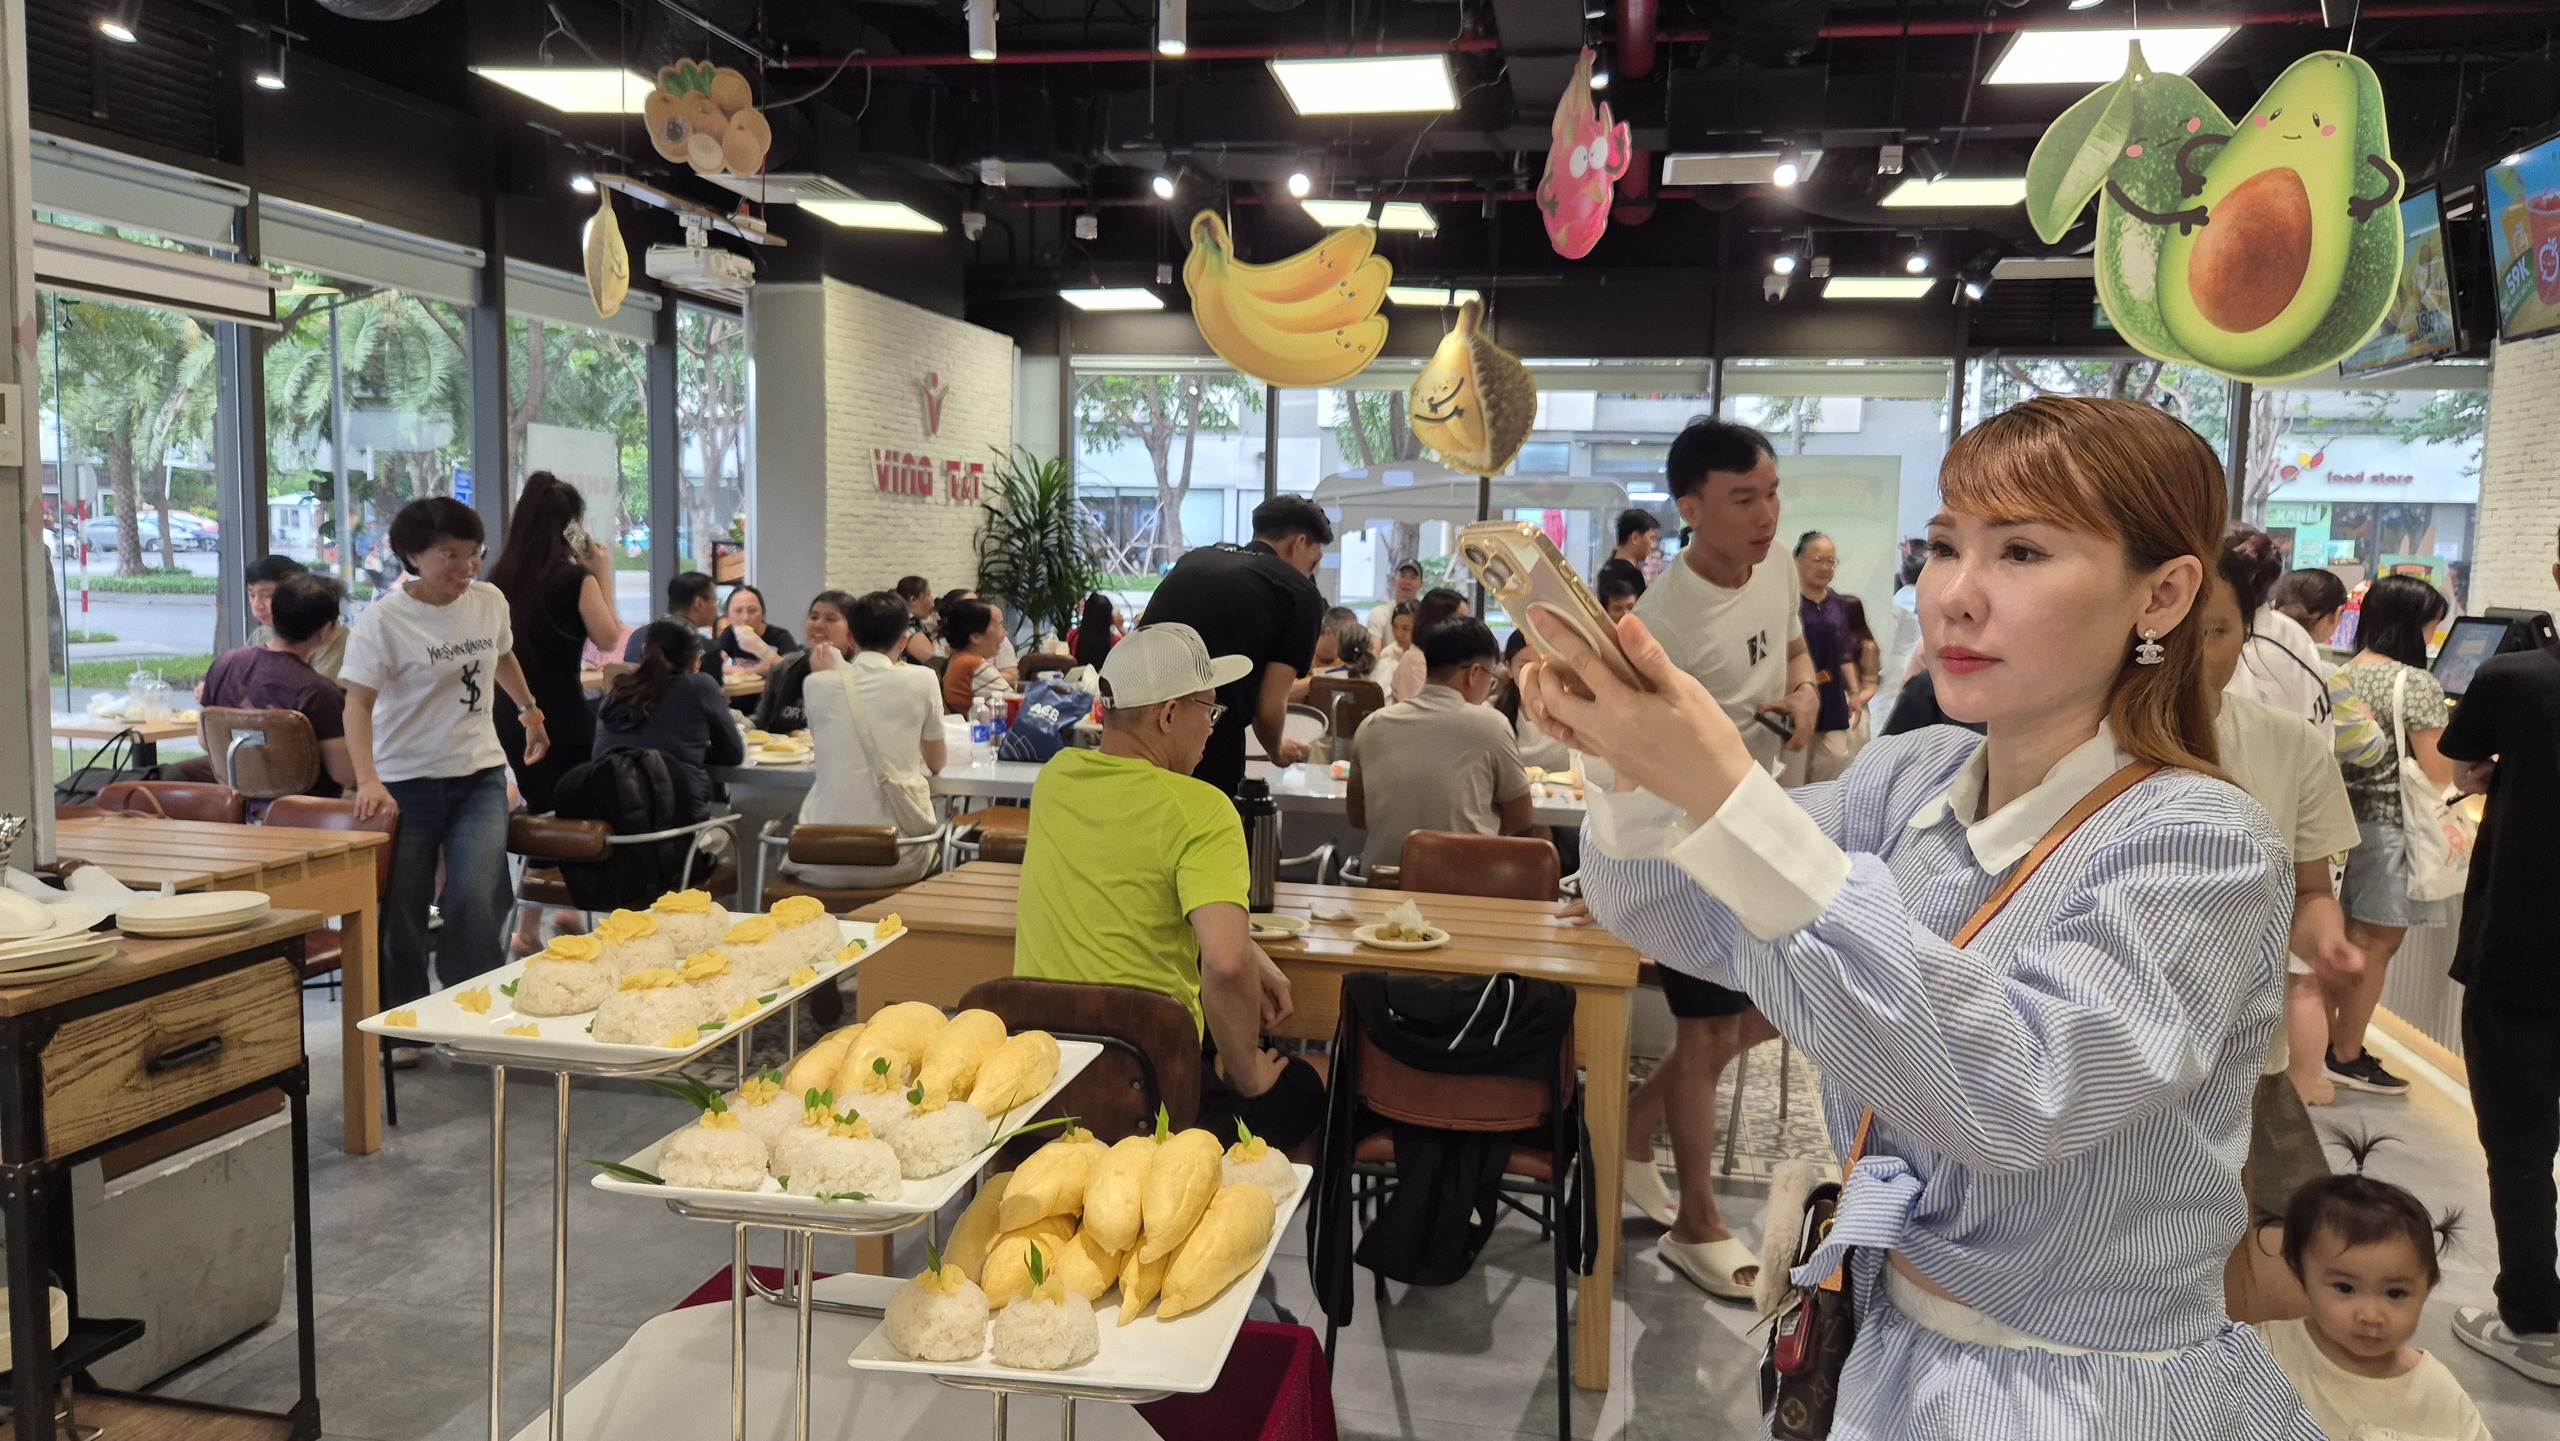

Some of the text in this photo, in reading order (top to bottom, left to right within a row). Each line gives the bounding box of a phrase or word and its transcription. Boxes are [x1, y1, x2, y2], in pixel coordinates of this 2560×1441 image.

[2505, 256, 2530, 295] 59K
[2327, 471, 2414, 485] food store
[1029, 702, 1060, 724] ACB
